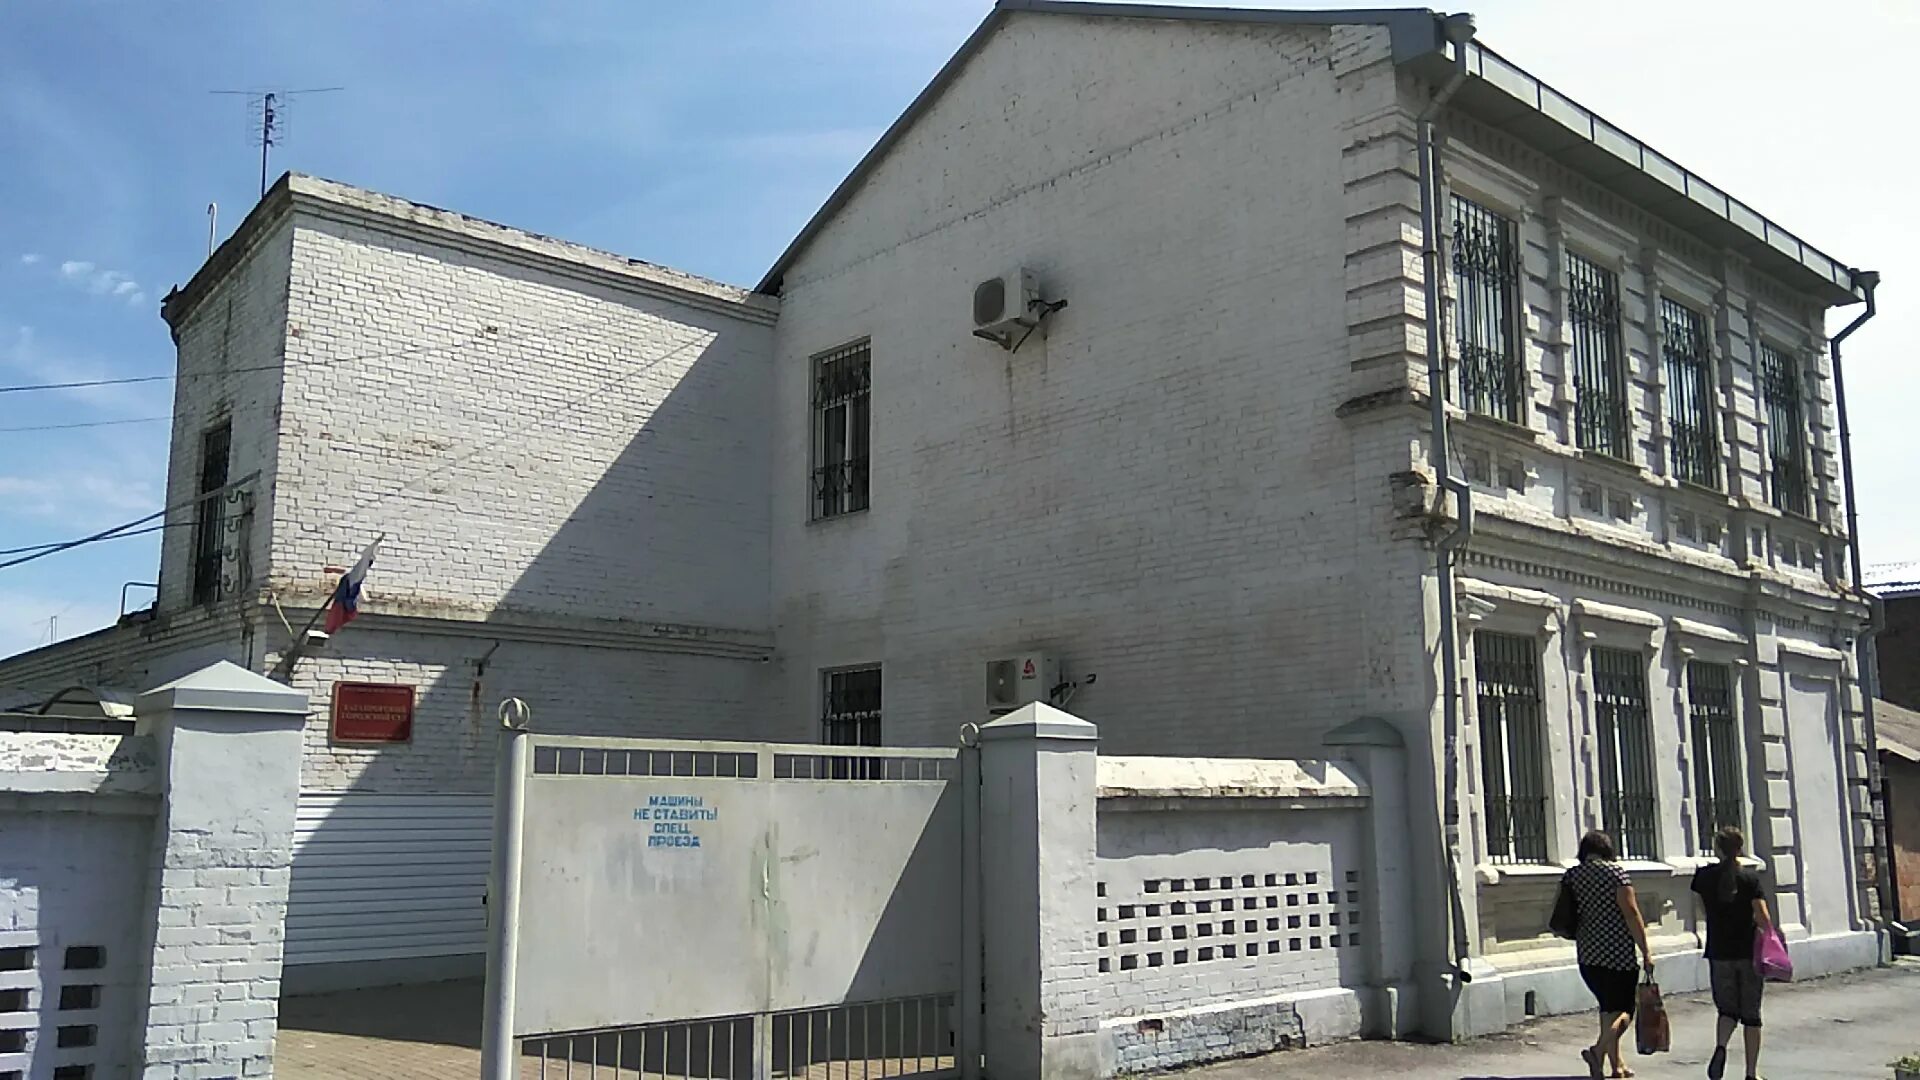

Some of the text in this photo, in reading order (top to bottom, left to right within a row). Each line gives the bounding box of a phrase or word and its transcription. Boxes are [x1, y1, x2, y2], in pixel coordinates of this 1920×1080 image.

[649, 796, 703, 806] МАШИНЫ
[634, 808, 650, 820] НЕ
[654, 822, 691, 834] СПЕЦ
